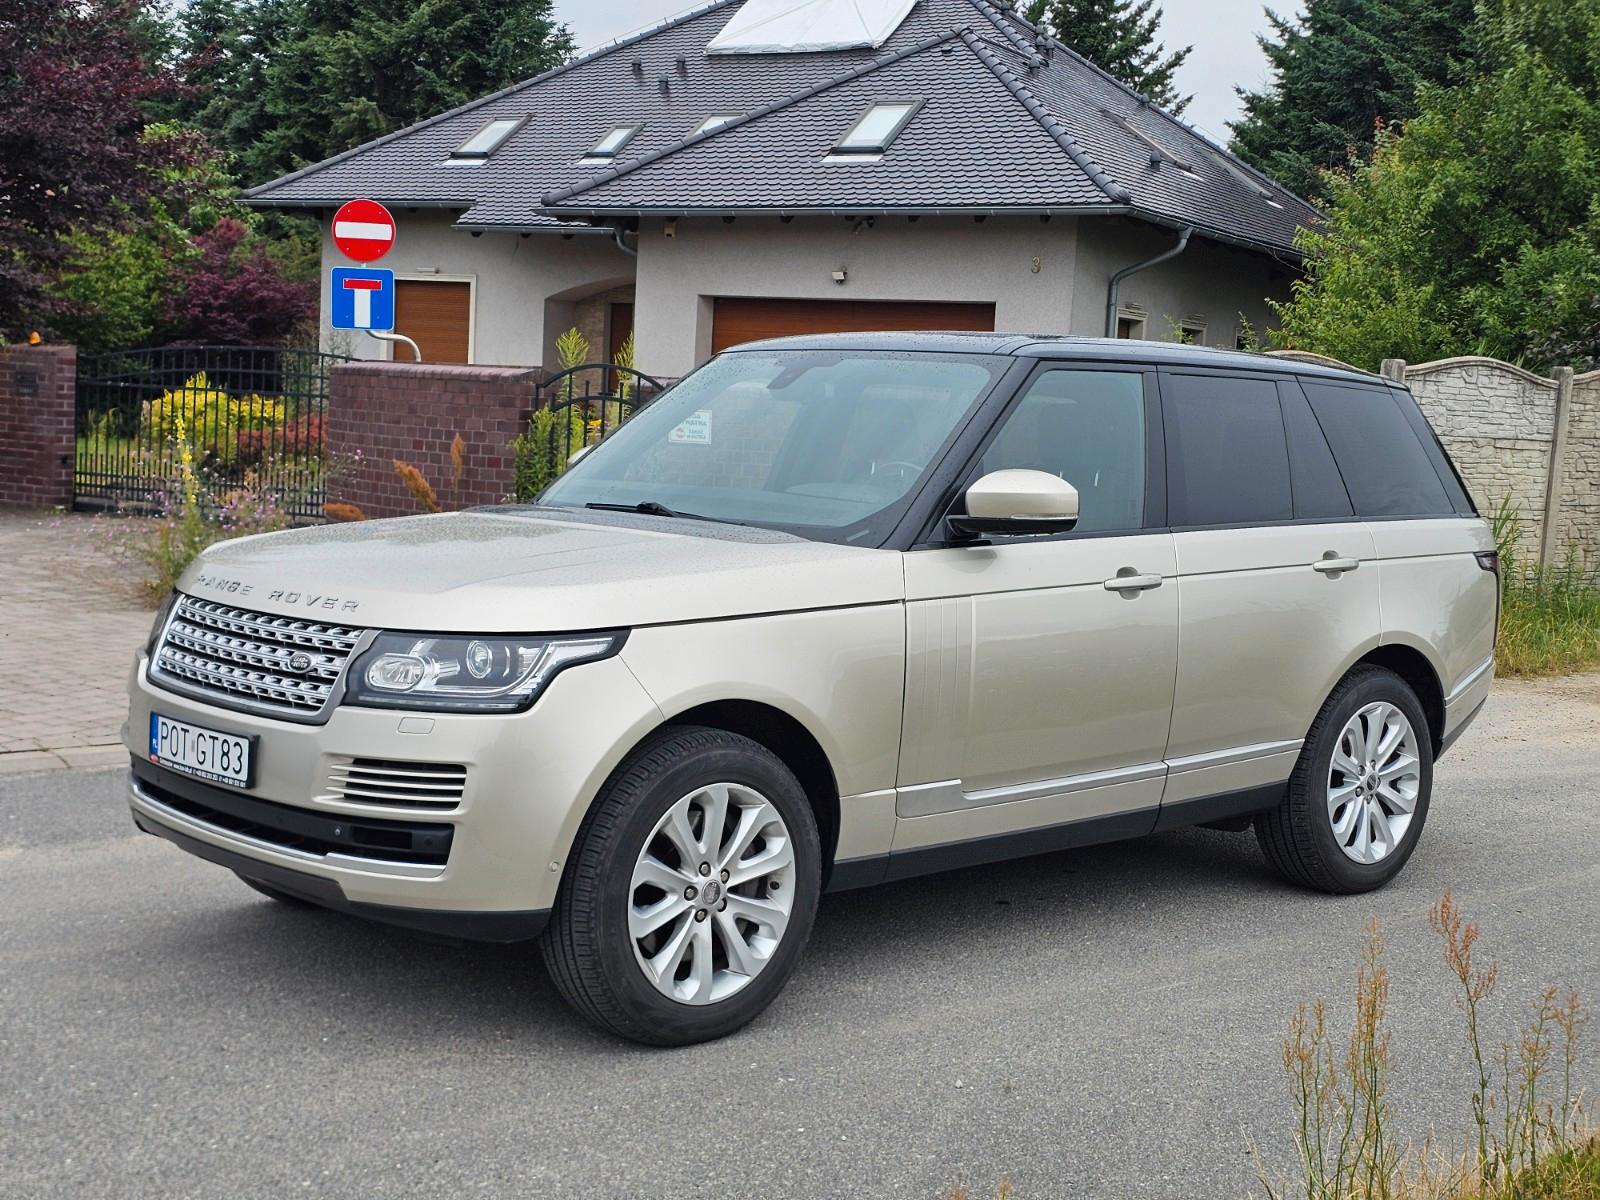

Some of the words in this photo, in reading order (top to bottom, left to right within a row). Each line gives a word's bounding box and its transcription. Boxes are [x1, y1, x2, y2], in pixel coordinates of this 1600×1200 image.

[1031, 255, 1041, 274] 3
[197, 574, 254, 596] RANGE
[268, 589, 359, 613] ROVER
[160, 721, 190, 761] POT
[196, 732, 243, 775] GT83
